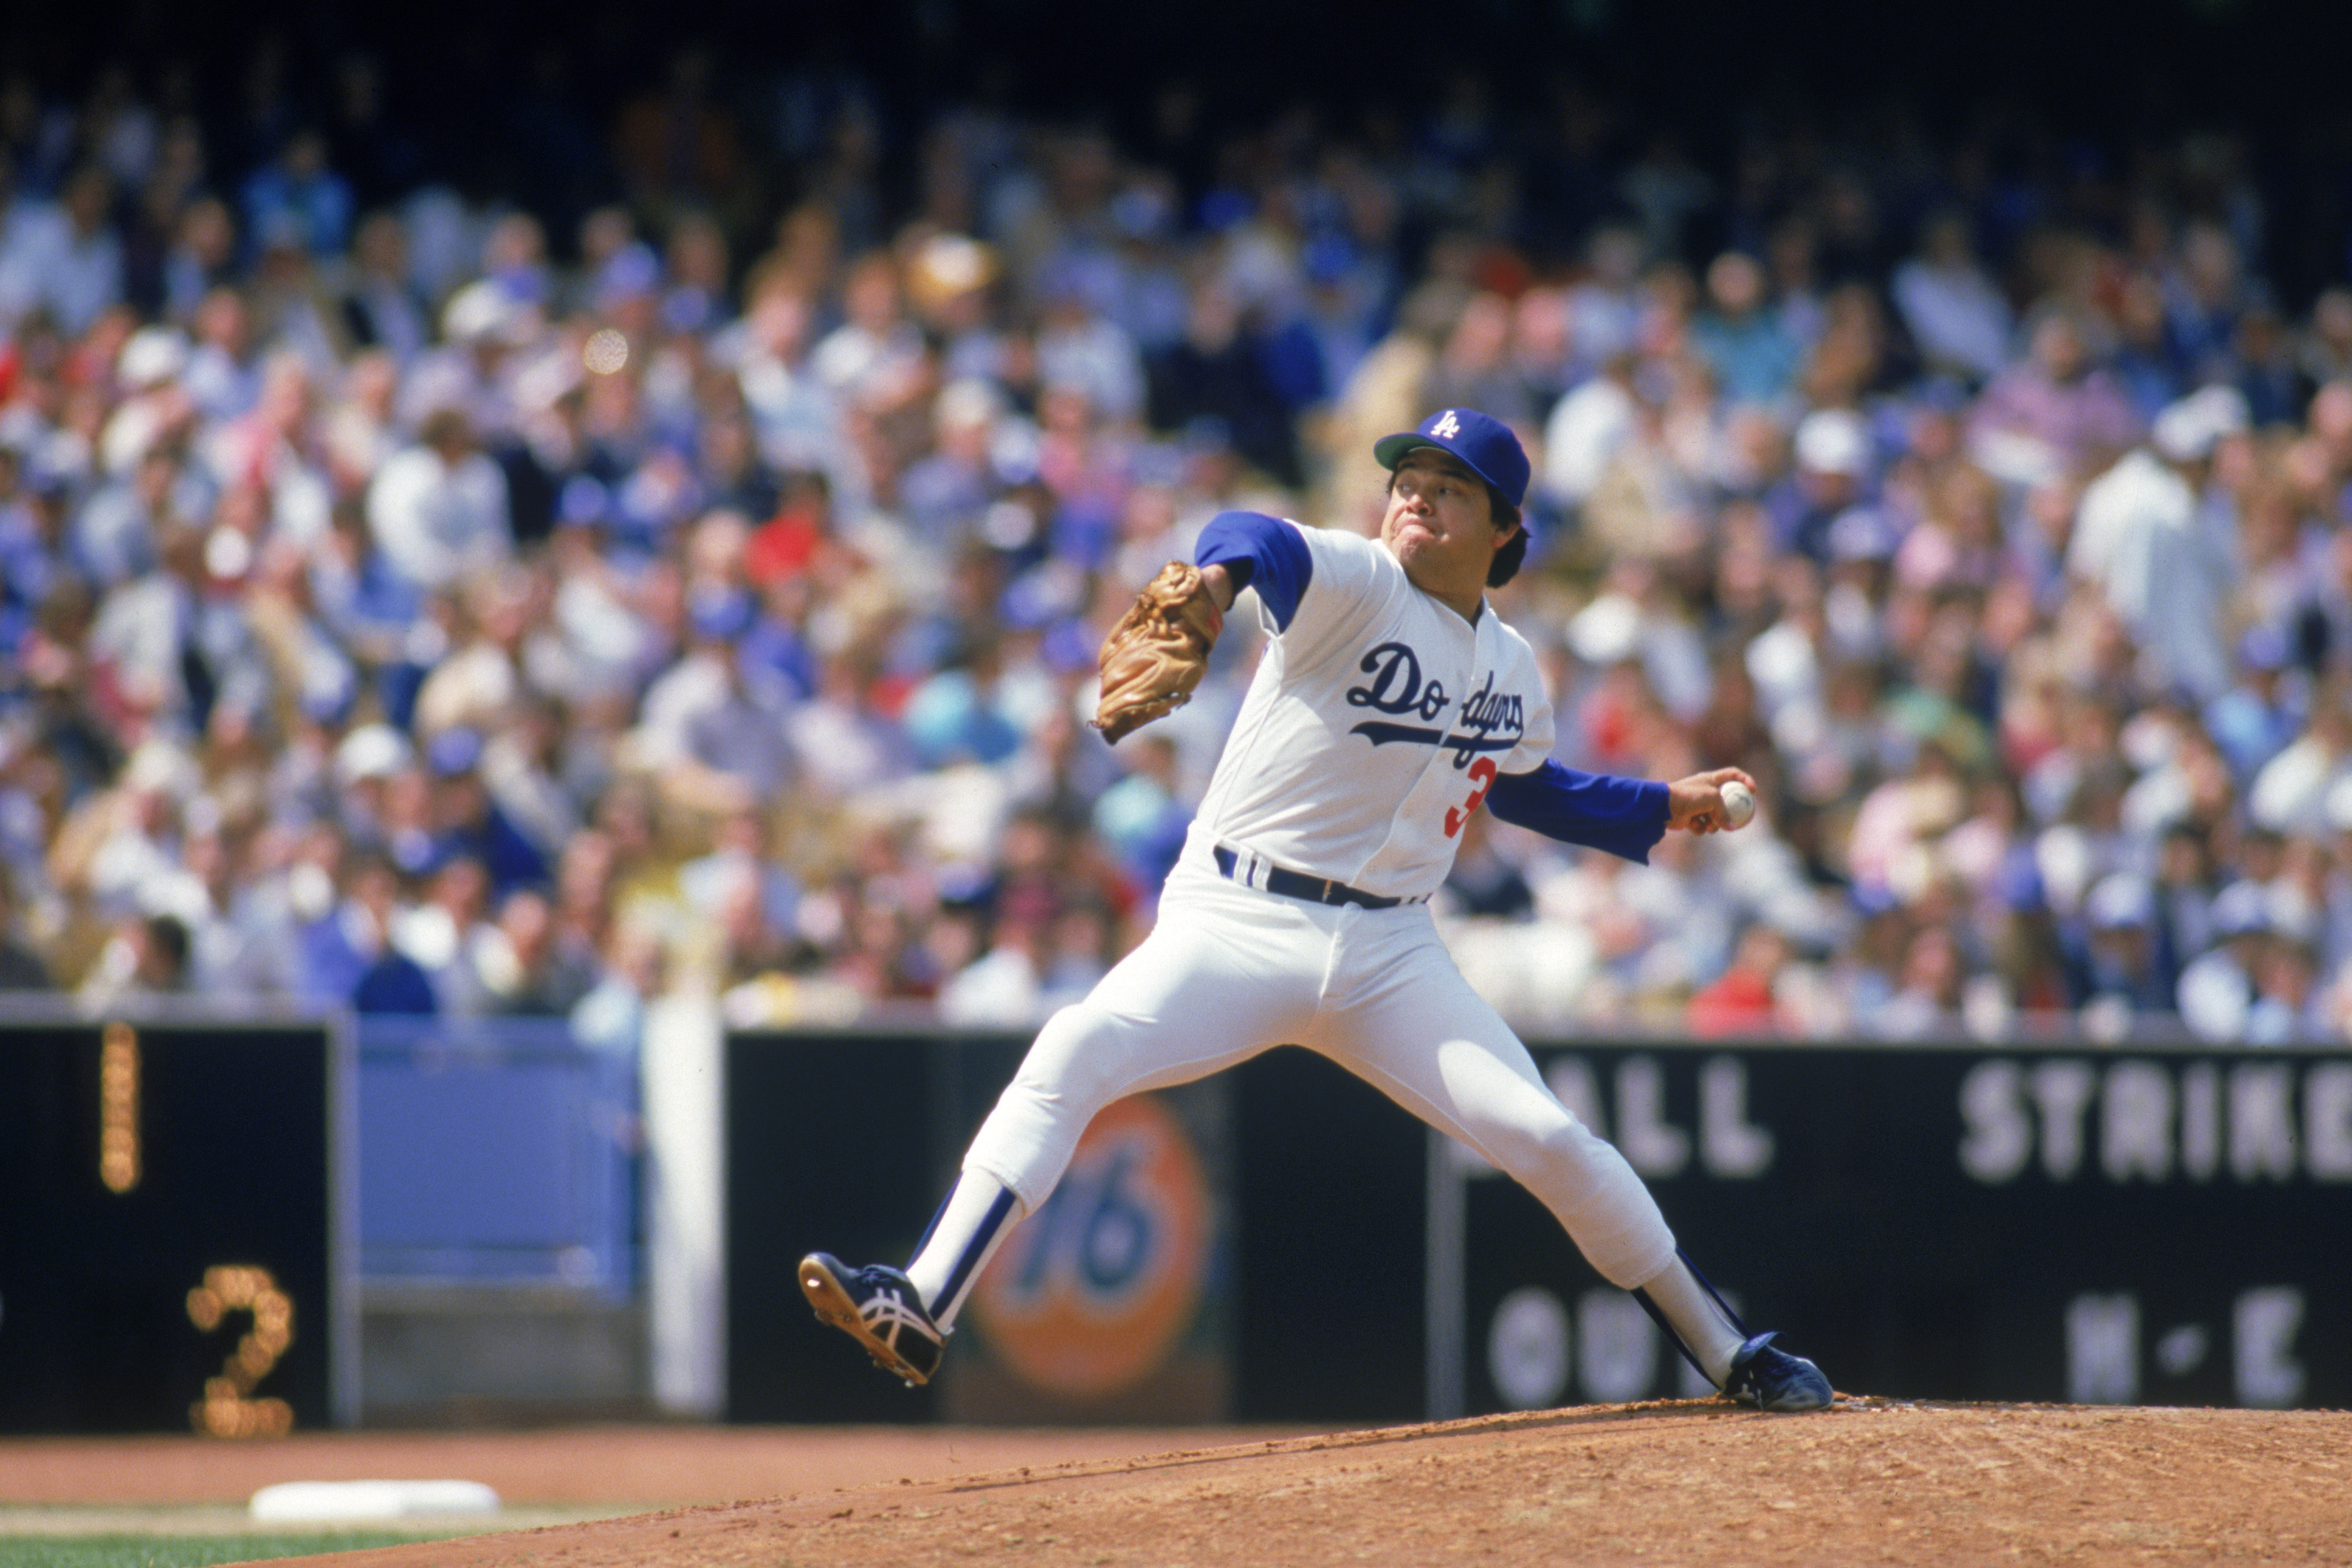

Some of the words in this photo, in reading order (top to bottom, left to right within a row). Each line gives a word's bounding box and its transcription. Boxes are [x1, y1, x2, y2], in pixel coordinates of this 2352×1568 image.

[1431, 410, 1461, 440] LA
[1346, 641, 1524, 770] Dodgers
[1444, 1053, 1774, 1178] ALL
[187, 1265, 294, 1437] 2
